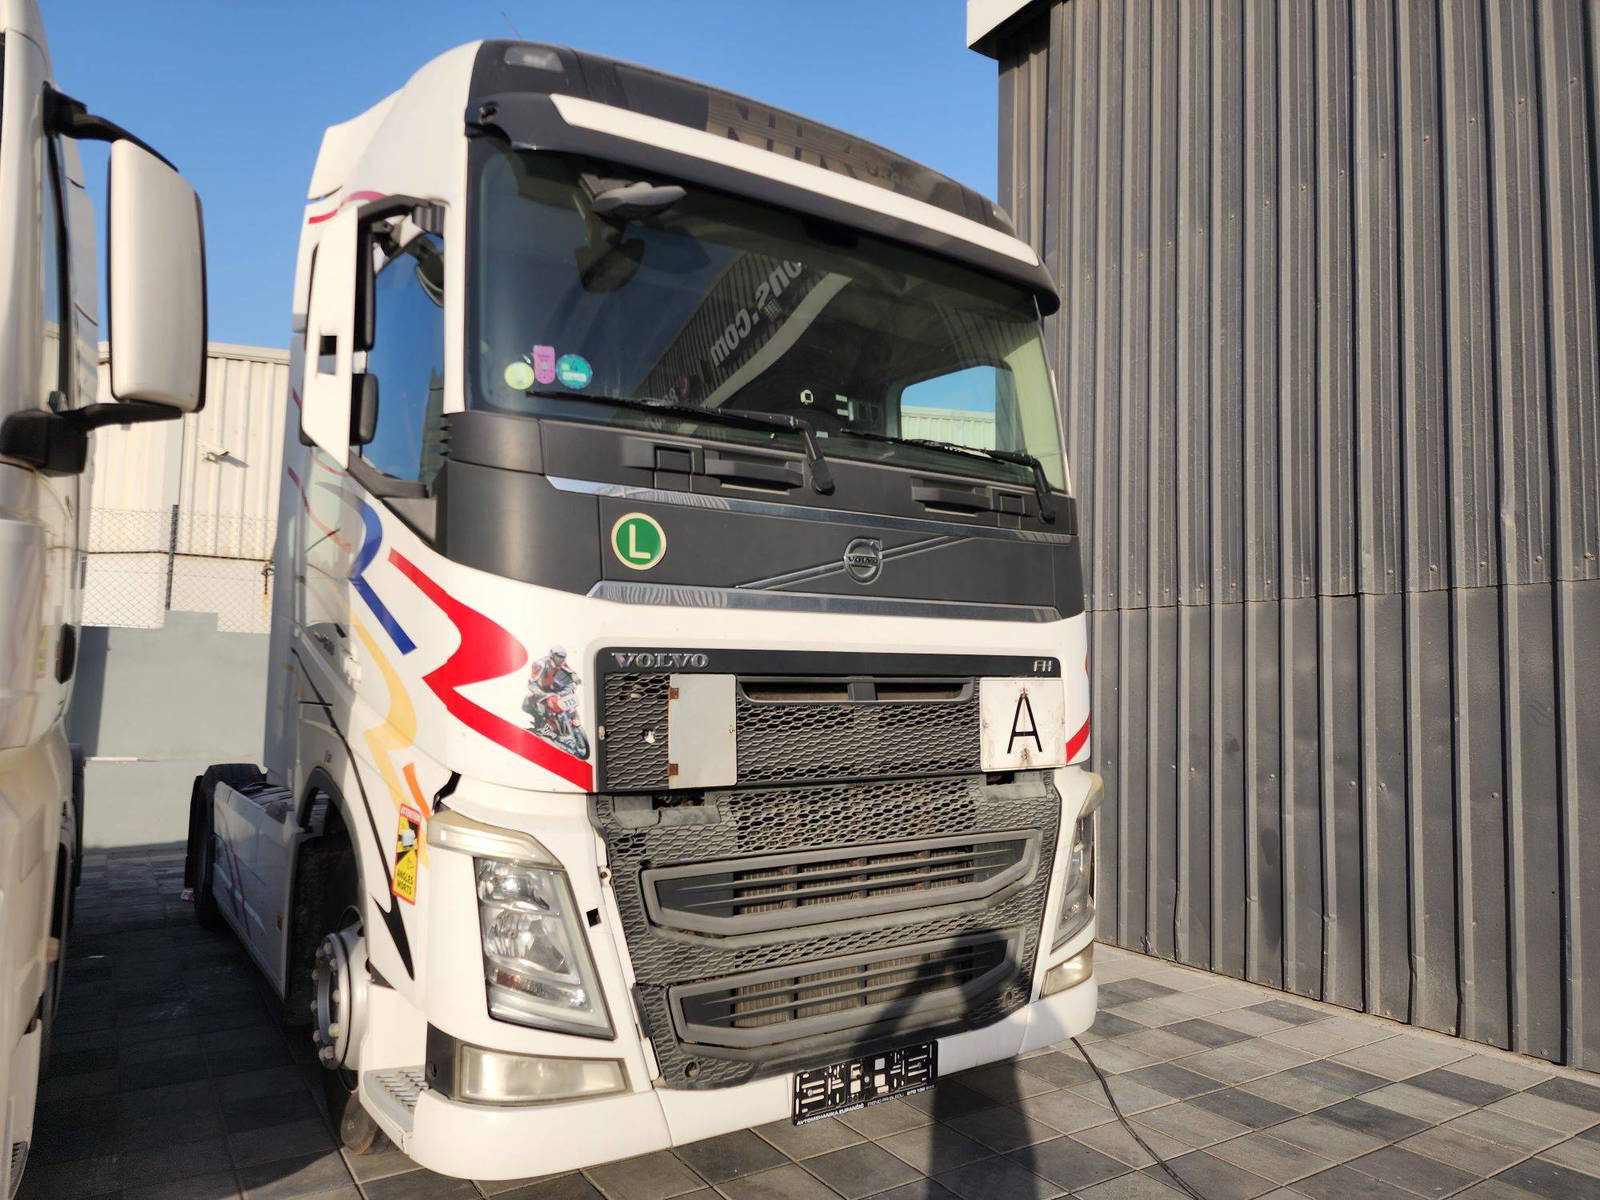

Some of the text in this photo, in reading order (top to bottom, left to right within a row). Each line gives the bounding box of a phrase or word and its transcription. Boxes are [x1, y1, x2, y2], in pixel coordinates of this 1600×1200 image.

[629, 524, 651, 559] L
[611, 652, 709, 668] VOLVO
[1033, 660, 1053, 673] FH
[1006, 692, 1043, 754] A
